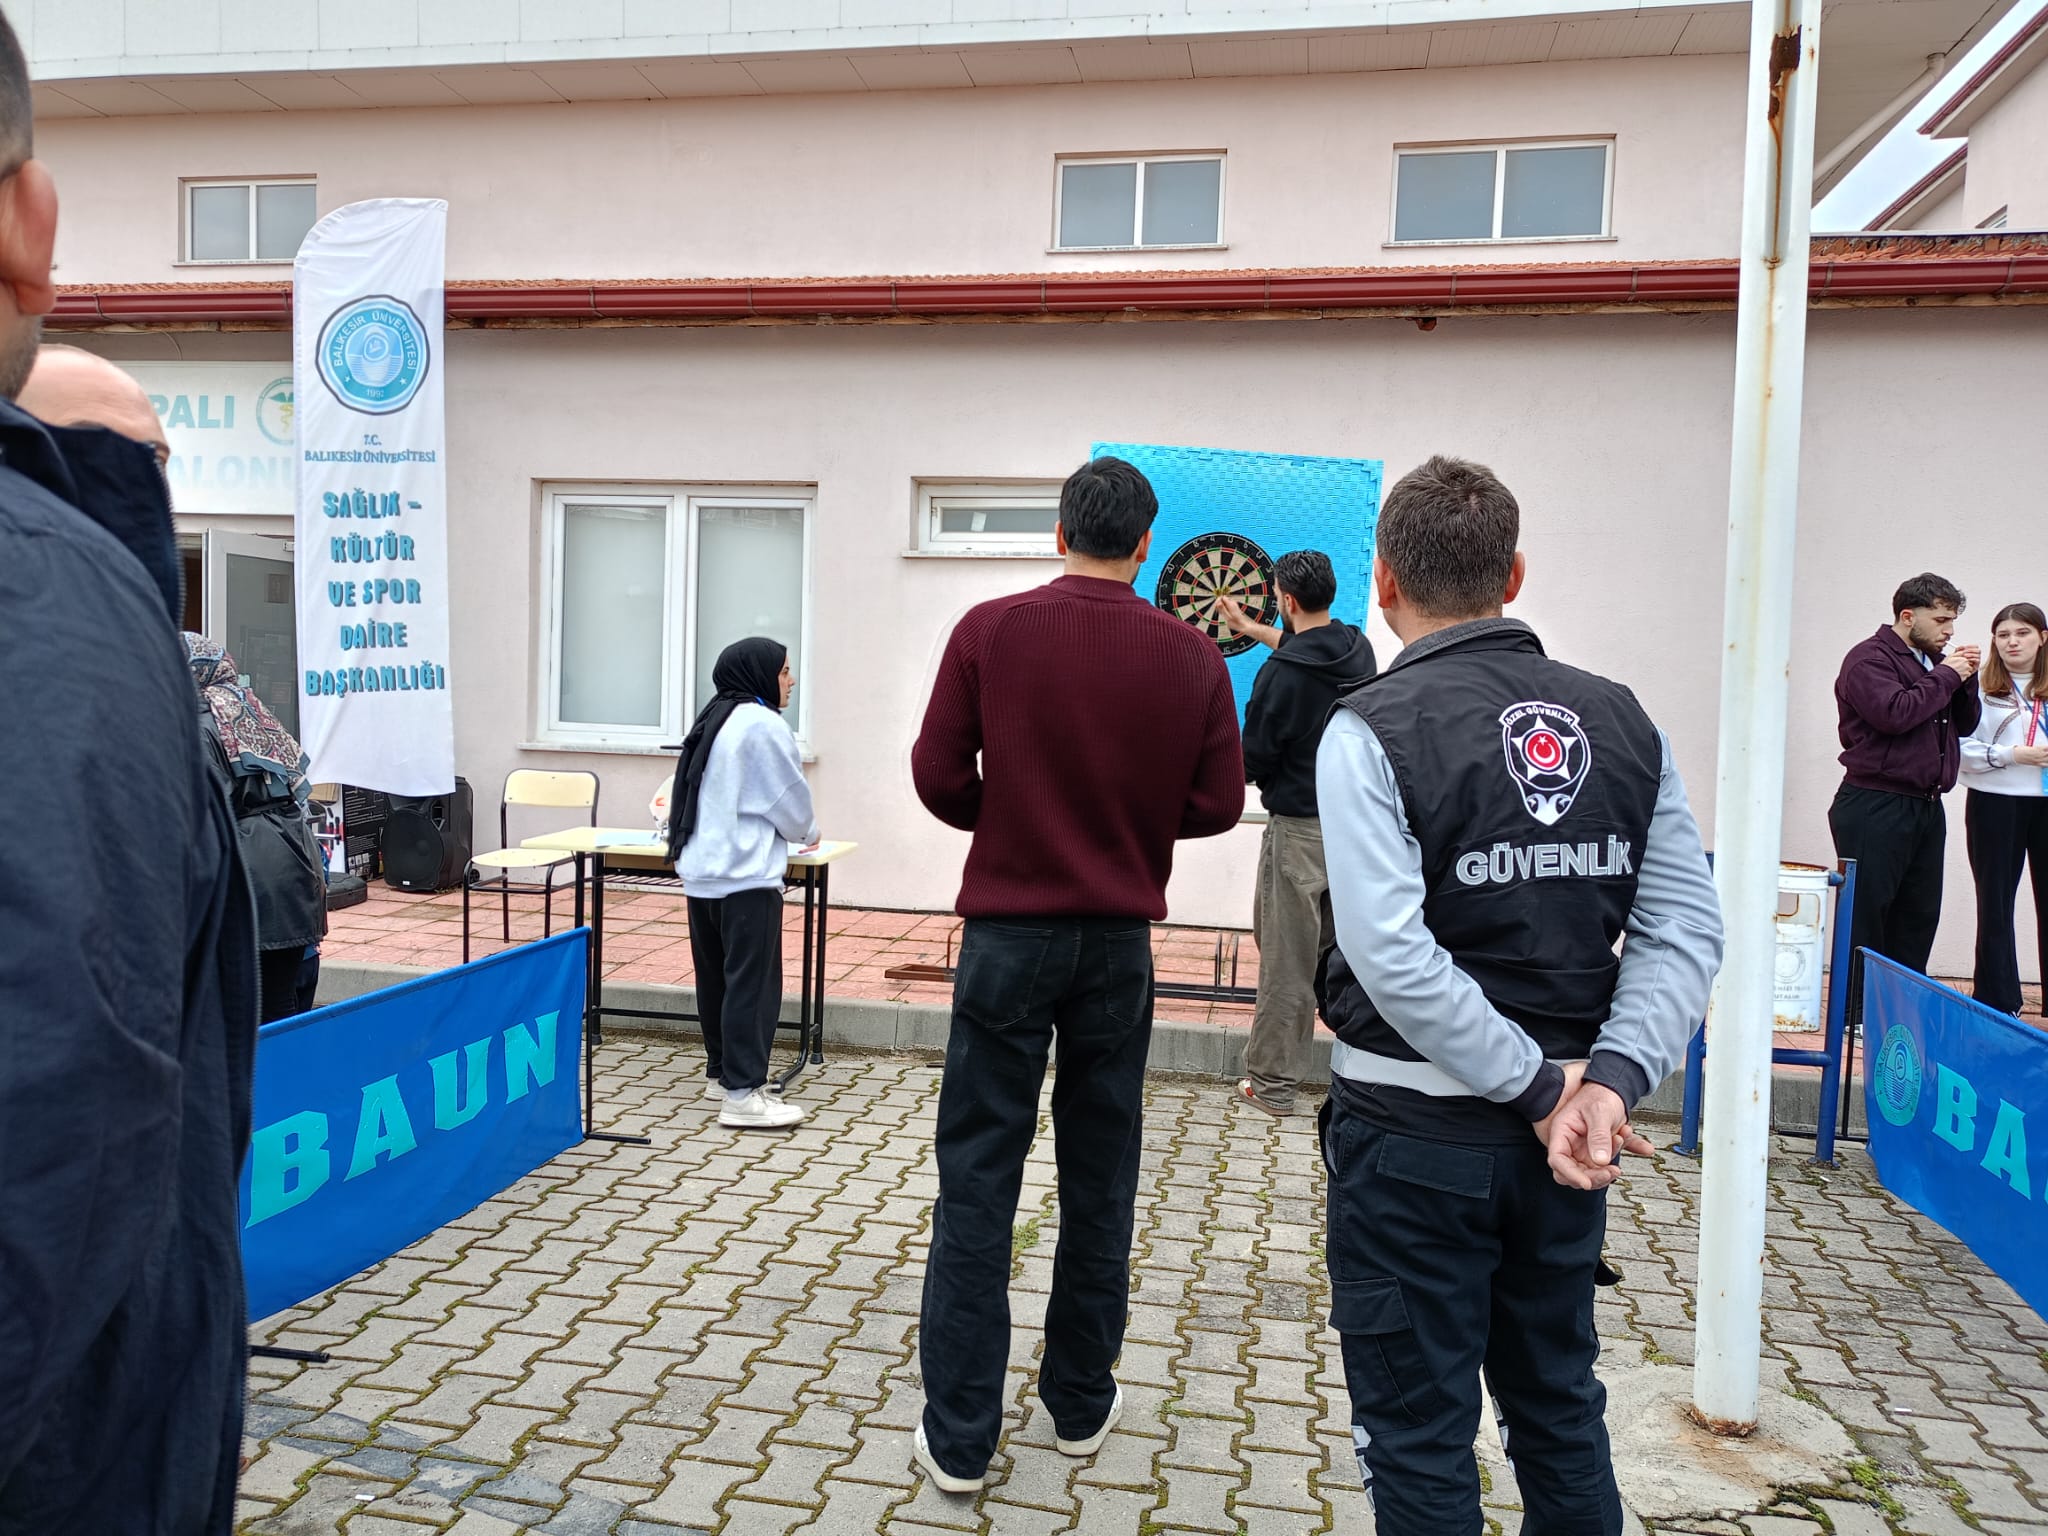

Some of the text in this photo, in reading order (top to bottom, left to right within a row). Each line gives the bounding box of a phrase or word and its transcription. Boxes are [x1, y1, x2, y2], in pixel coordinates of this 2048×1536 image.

[322, 488, 401, 519] SAĞLIK
[330, 529, 416, 563] KÜLTÜR
[362, 578, 422, 605] SPOR
[340, 618, 408, 651] DAİRE
[305, 660, 446, 699] BAŞKANLIĞI
[1505, 708, 1526, 725] ÖZEL
[1455, 834, 1633, 886] GÜVENLİK
[245, 1009, 560, 1229] BAUN
[1931, 1062, 2048, 1205] BA
